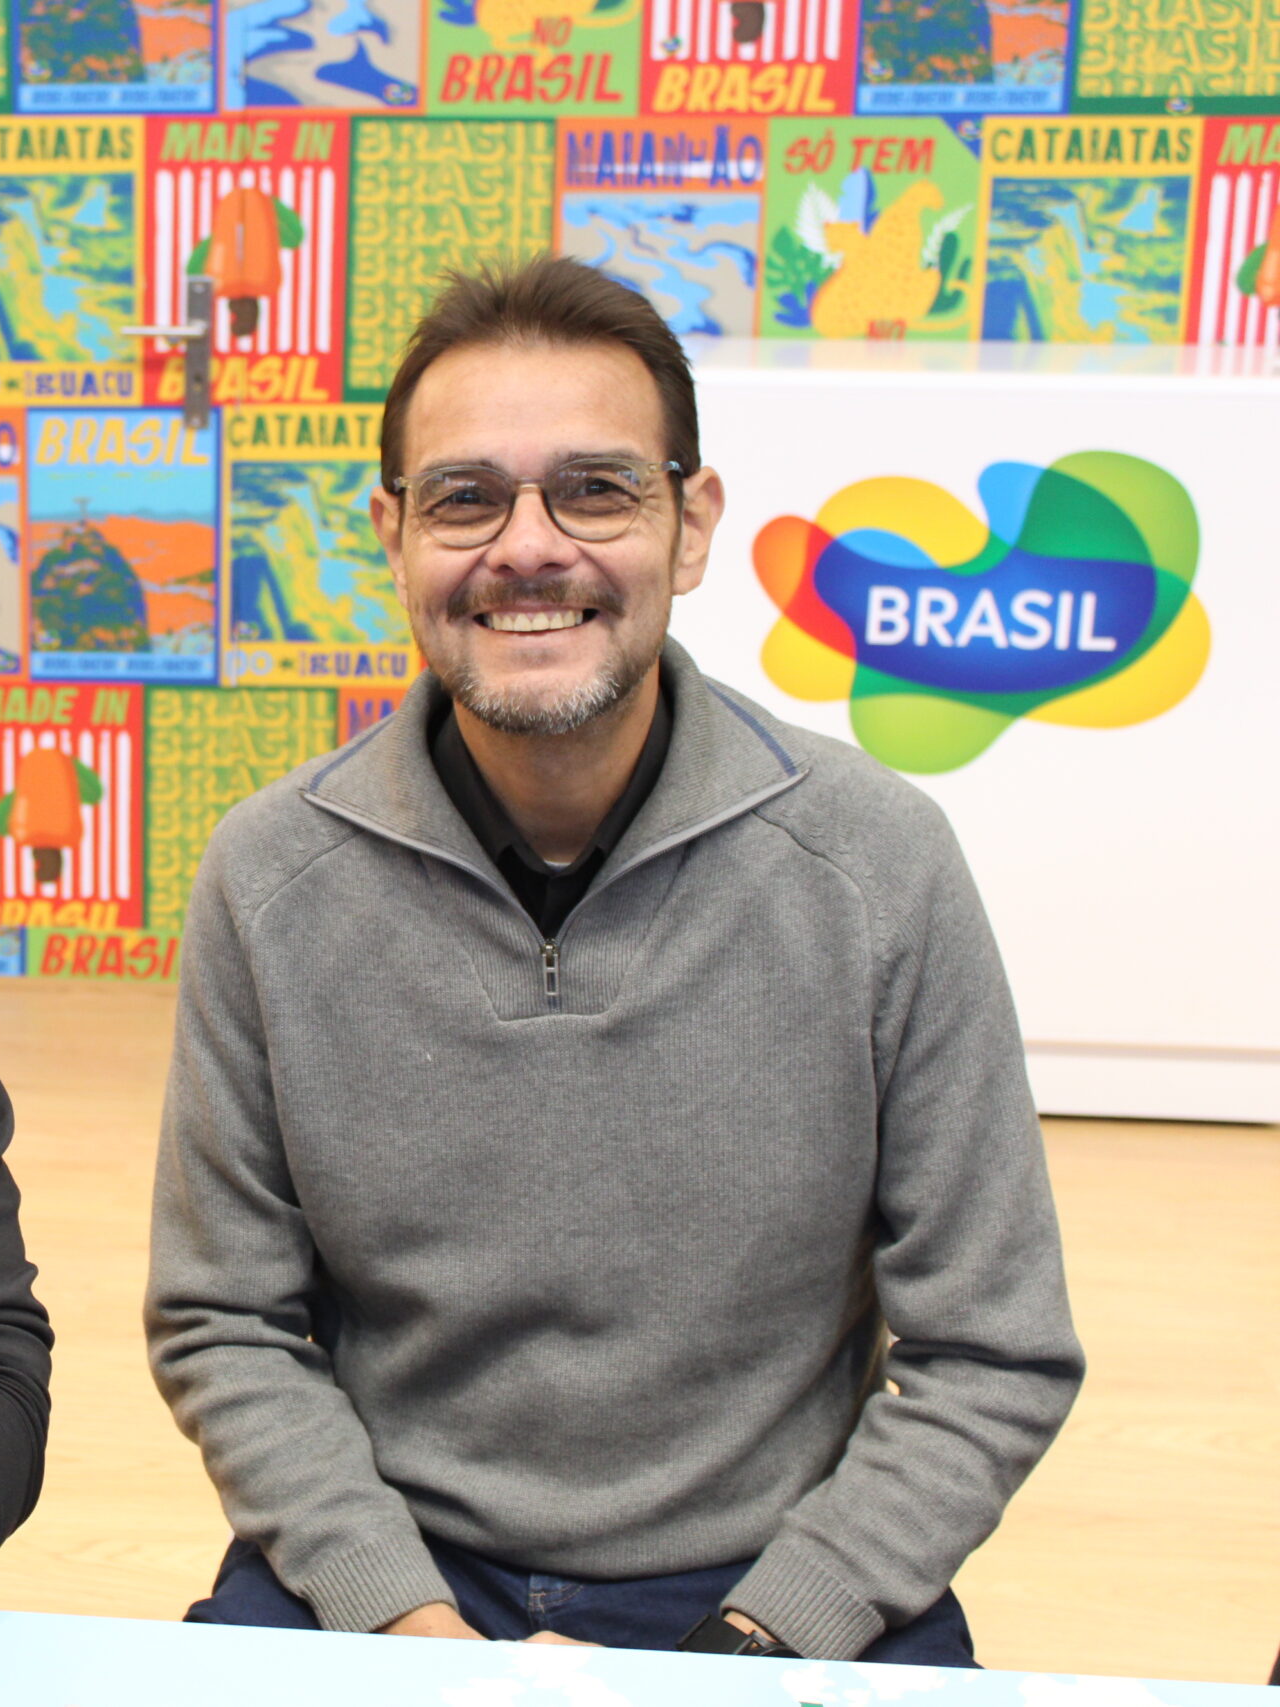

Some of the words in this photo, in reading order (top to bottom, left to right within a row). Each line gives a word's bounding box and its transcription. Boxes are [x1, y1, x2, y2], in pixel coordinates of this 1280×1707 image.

[530, 15, 574, 48] NO
[440, 53, 624, 104] BRASIL
[651, 64, 837, 114] BRASIL
[159, 120, 281, 164] MADE
[292, 120, 336, 164] IN
[783, 126, 836, 175] SÓ
[850, 136, 936, 175] TEM
[34, 416, 210, 466] BRASIL
[865, 584, 1117, 652] BRASIL
[90, 688, 131, 727] IN
[40, 932, 181, 979] BRASI
